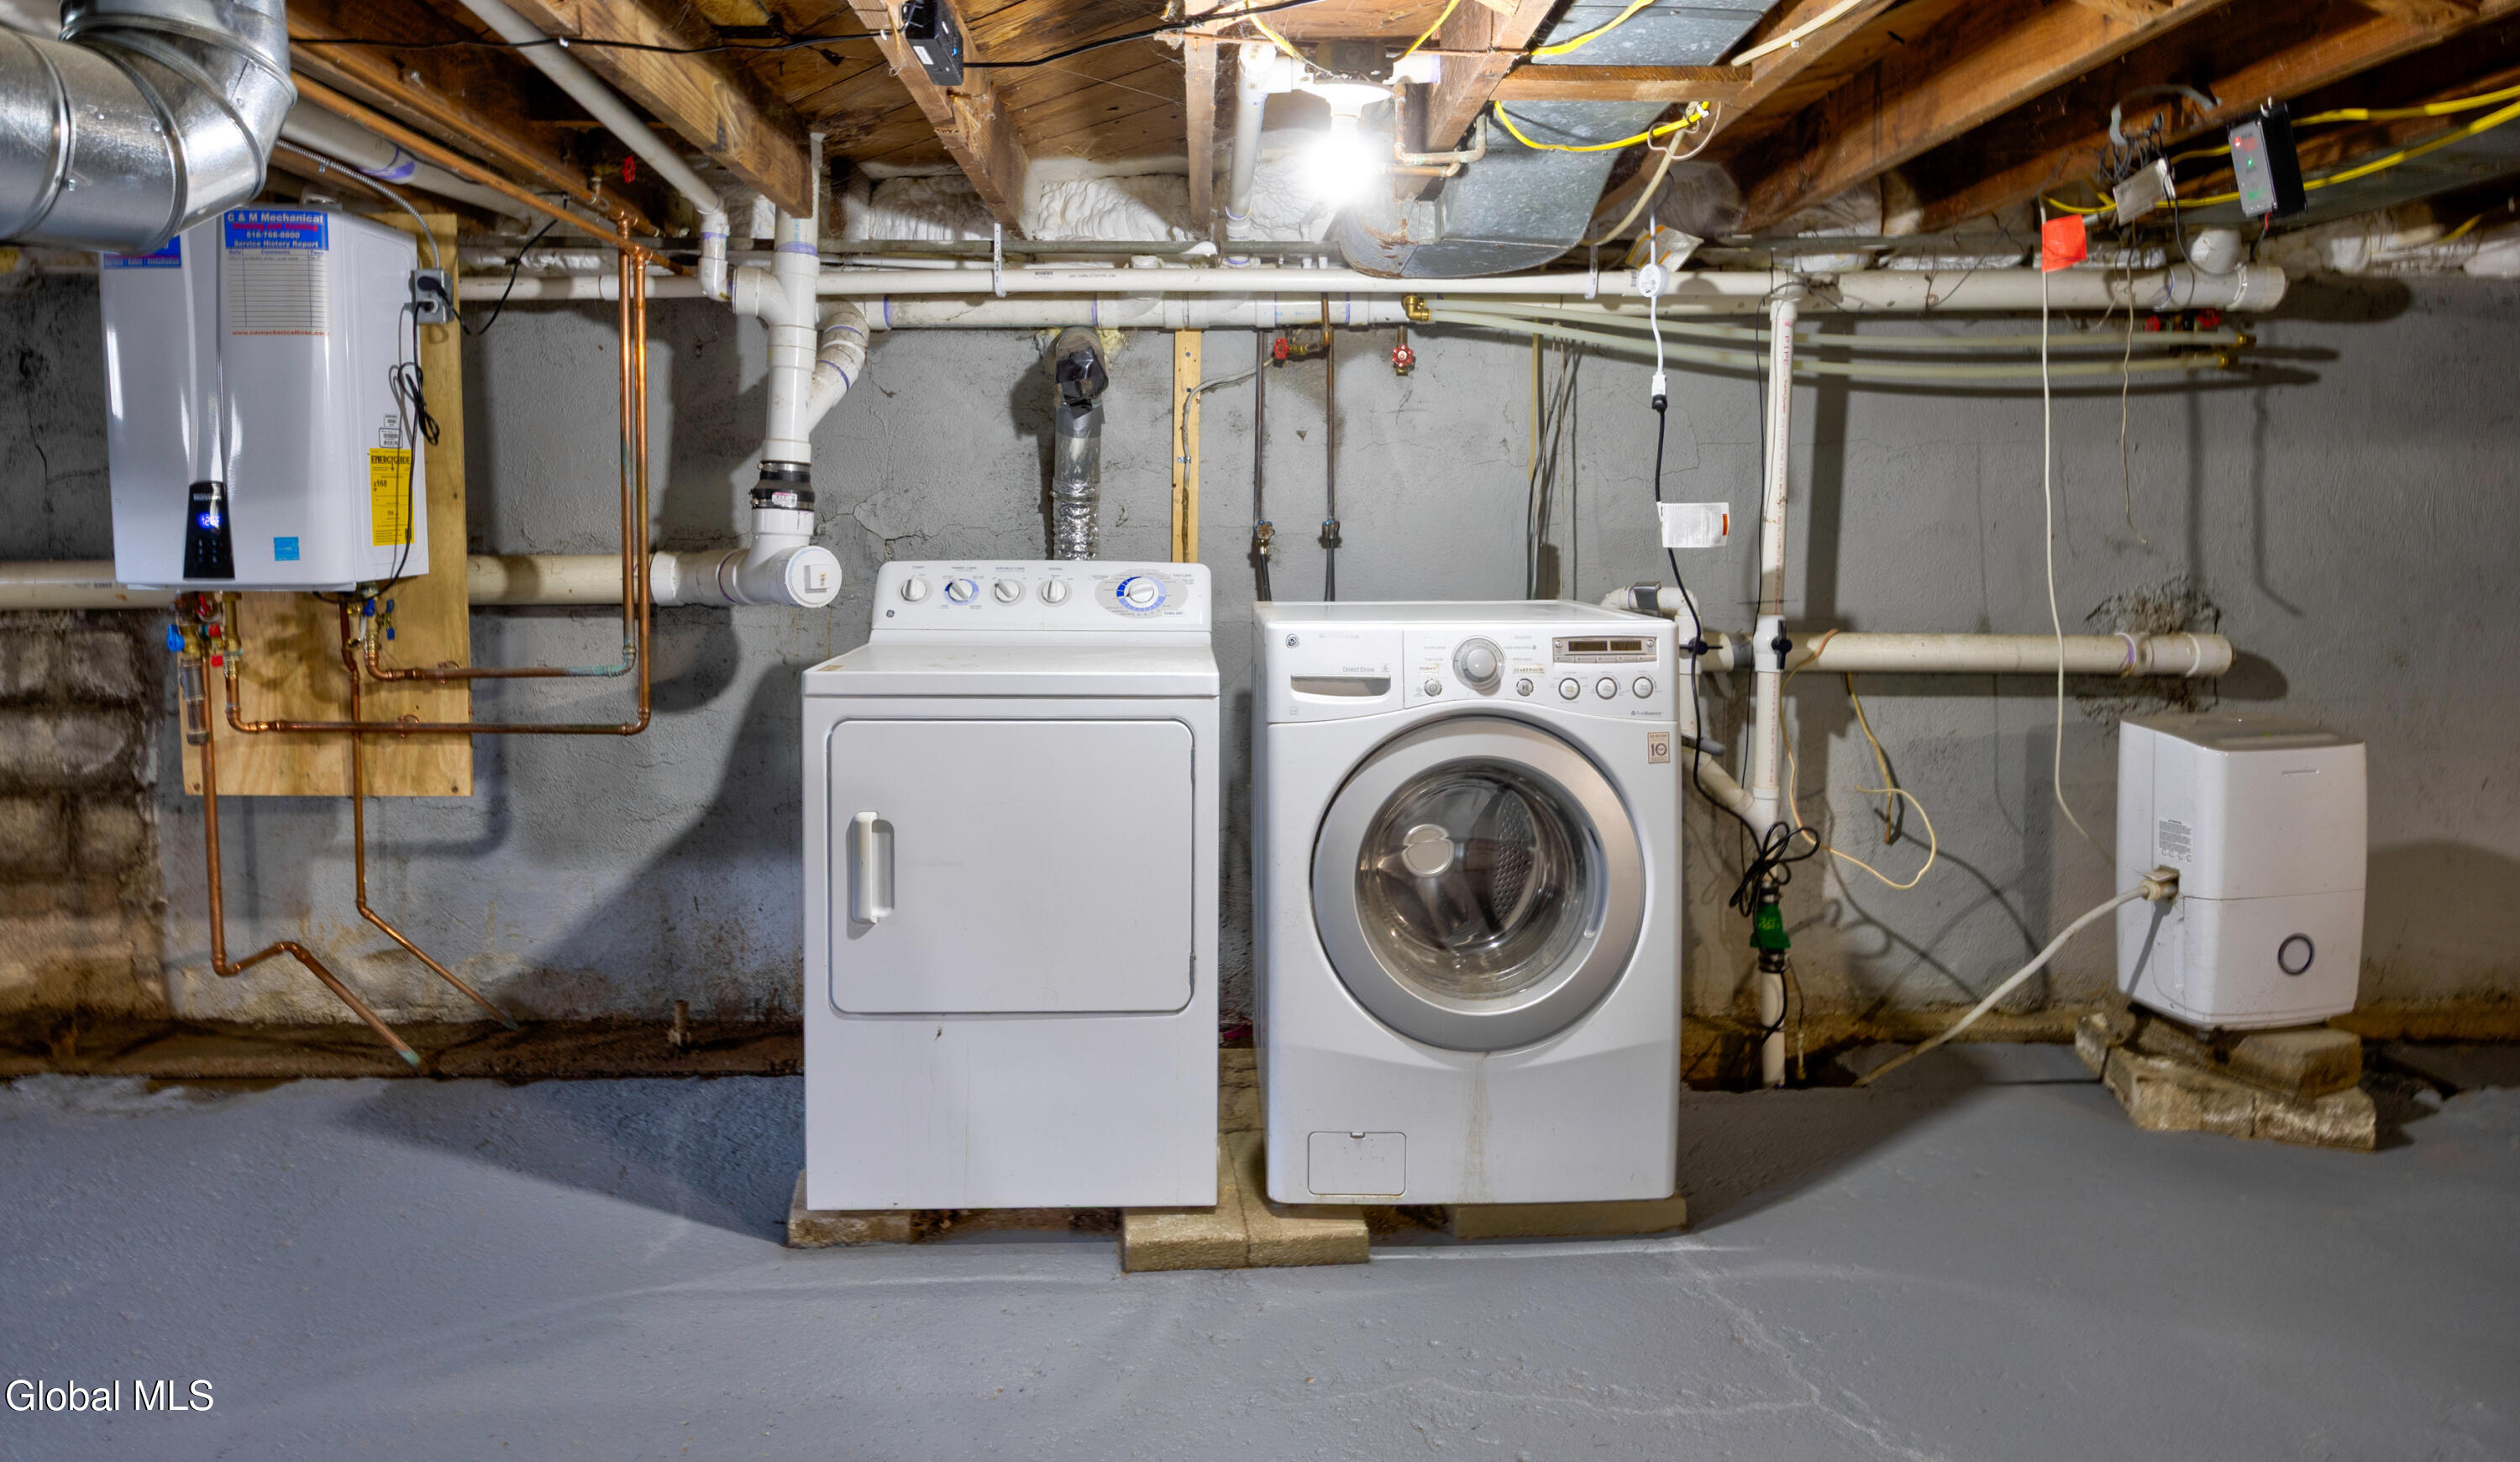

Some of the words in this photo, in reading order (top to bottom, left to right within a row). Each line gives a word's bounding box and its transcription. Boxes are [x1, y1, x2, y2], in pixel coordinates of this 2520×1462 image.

[228, 213, 234, 223] C
[238, 213, 246, 223] &
[249, 213, 258, 223] M
[260, 213, 323, 224] Mechanical
[263, 240, 291, 249] History
[292, 240, 319, 249] Report
